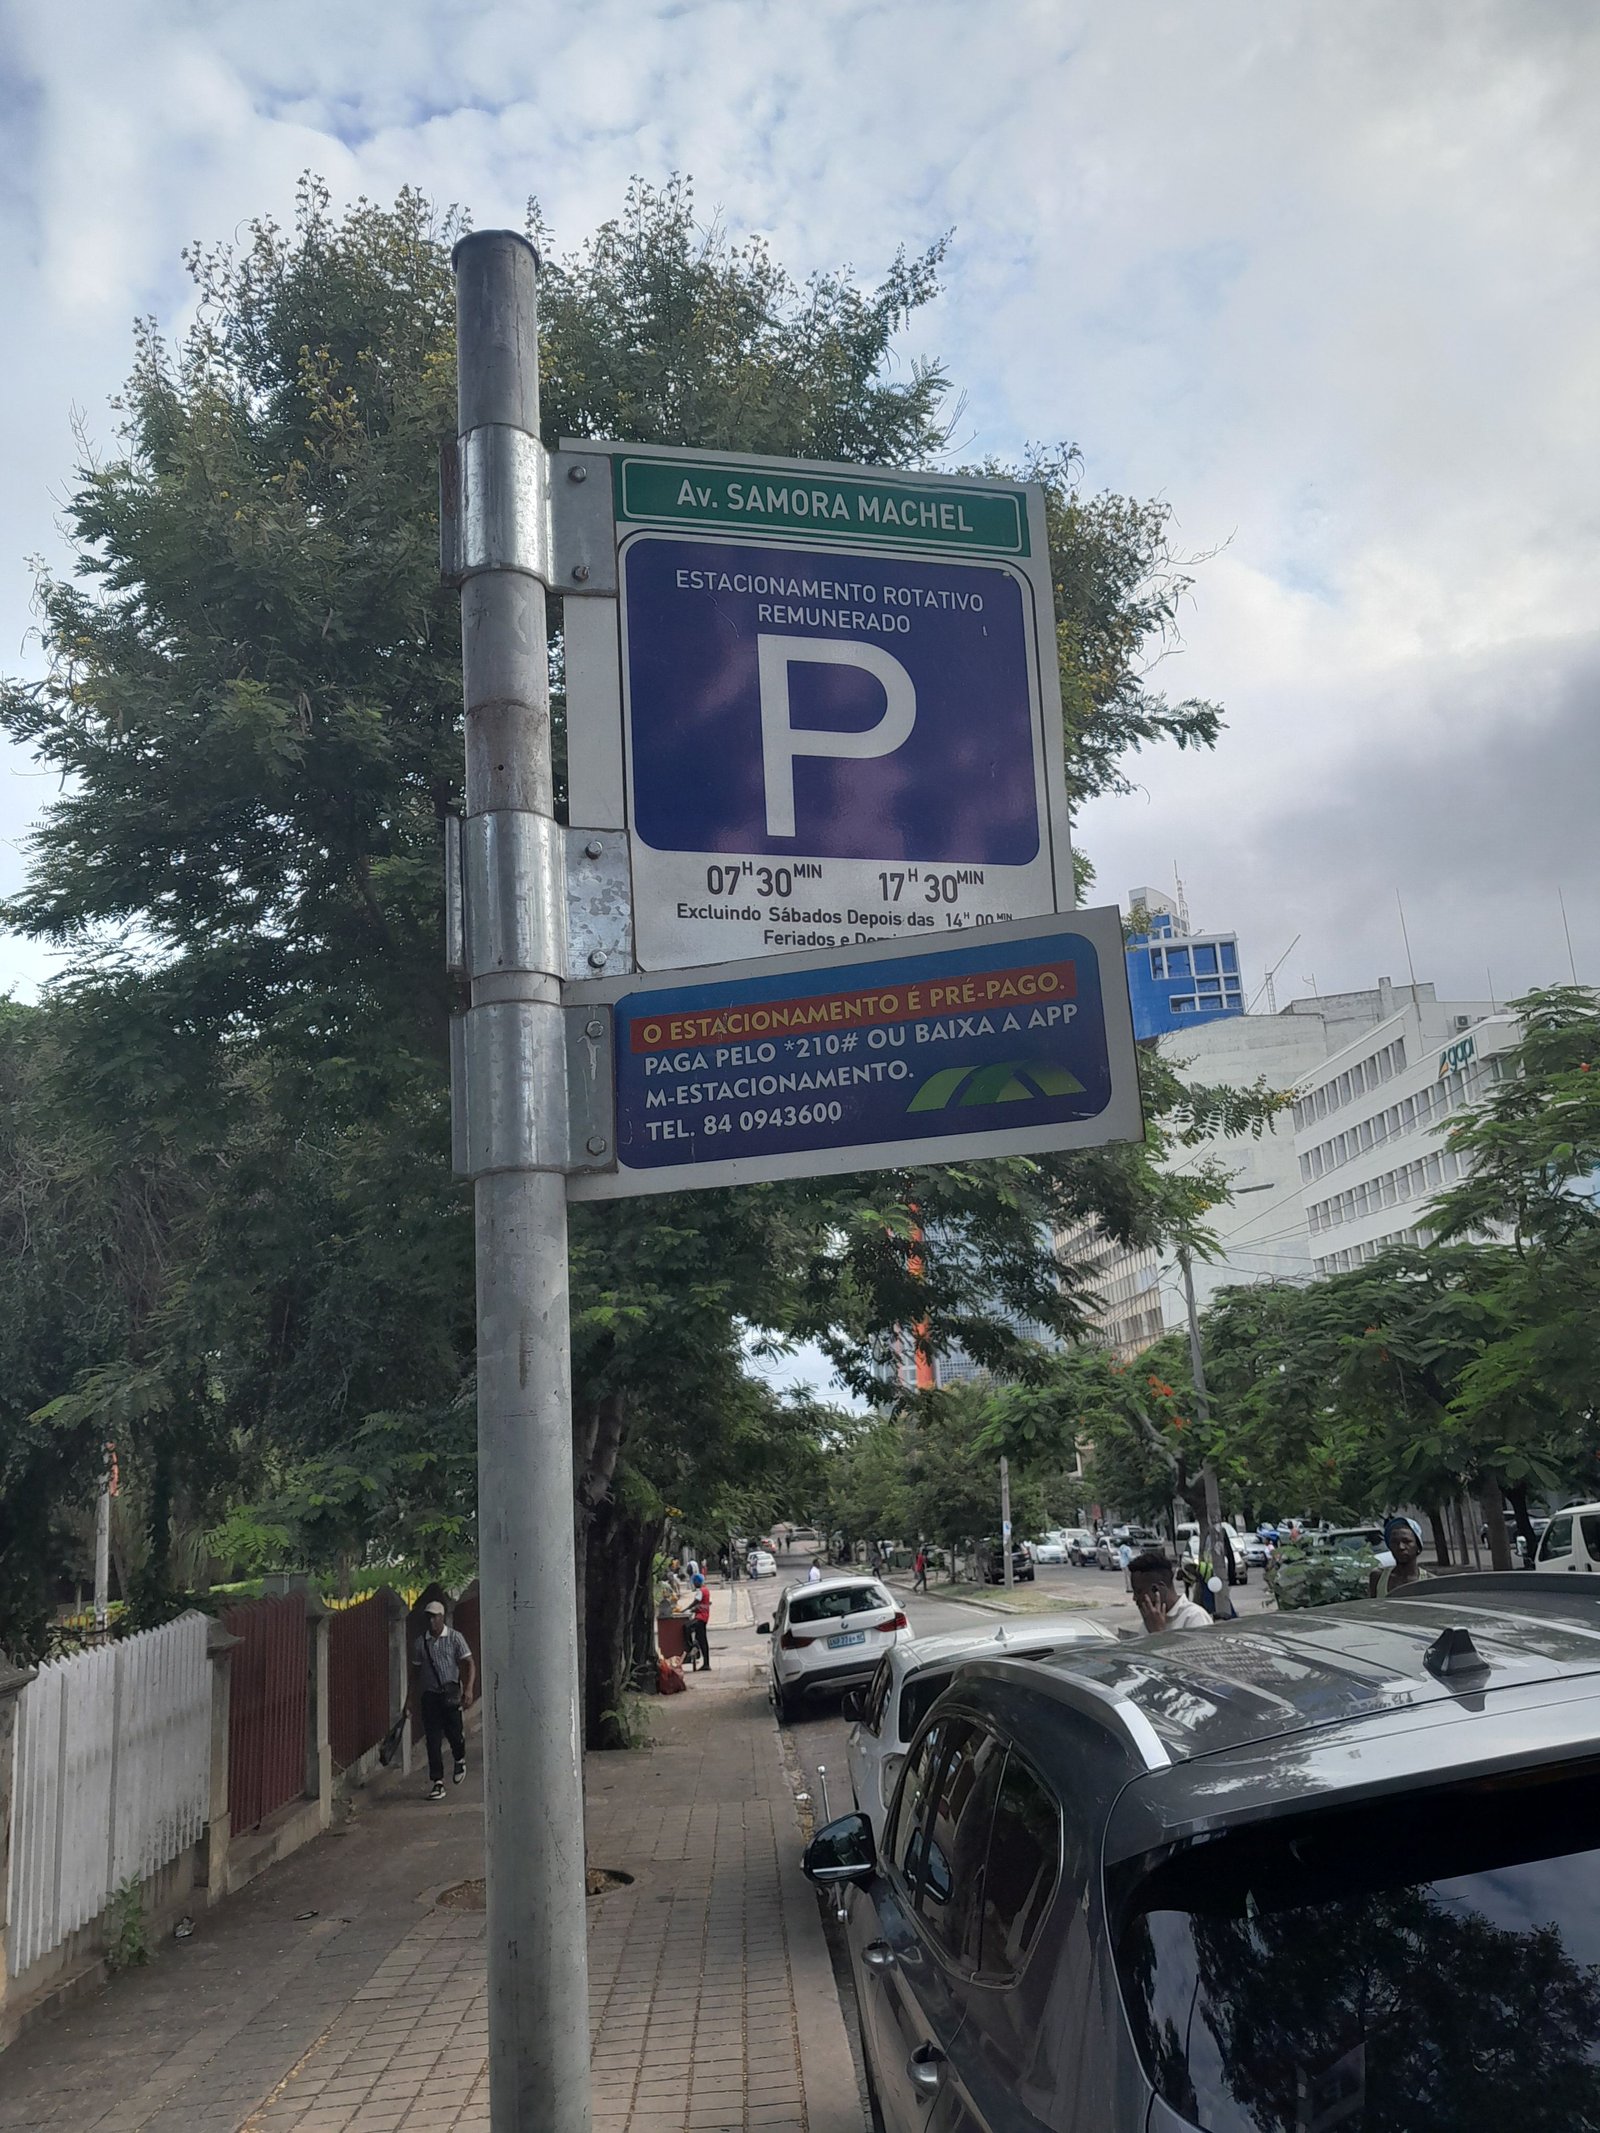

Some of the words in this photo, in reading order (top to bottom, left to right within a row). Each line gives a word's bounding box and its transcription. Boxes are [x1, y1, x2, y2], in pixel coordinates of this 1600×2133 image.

[677, 479, 718, 508] Av.
[727, 483, 850, 521] SAMORA
[858, 495, 974, 532] MACHEL
[676, 570, 877, 603] ESTACIONAMENTO
[883, 586, 984, 612] ROTATIVO
[758, 604, 911, 633] REMUNERADO
[757, 633, 917, 837] P
[677, 903, 761, 921] Excluindo
[769, 907, 842, 923] Sábados
[847, 909, 902, 928] Depois
[907, 912, 935, 927] das
[764, 930, 836, 947] Feriados
[840, 936, 850, 946] e
[643, 1024, 662, 1044] O
[670, 994, 899, 1041] ESTACIONAMENTO
[907, 985, 921, 1010] É
[929, 972, 1065, 1008] PRÉ-PAGO.
[644, 1052, 709, 1076] PAGA
[716, 1043, 776, 1067] PELO
[867, 1026, 906, 1049] OU
[915, 1016, 995, 1044] BAIXA
[1002, 1011, 1021, 1033] A
[1027, 1003, 1079, 1030] APP
[645, 1060, 914, 1108] M-ESTACIONAMENTO.
[646, 1119, 695, 1141] TEL.
[703, 1114, 732, 1136] 84
[739, 1101, 842, 1132] 0943600
